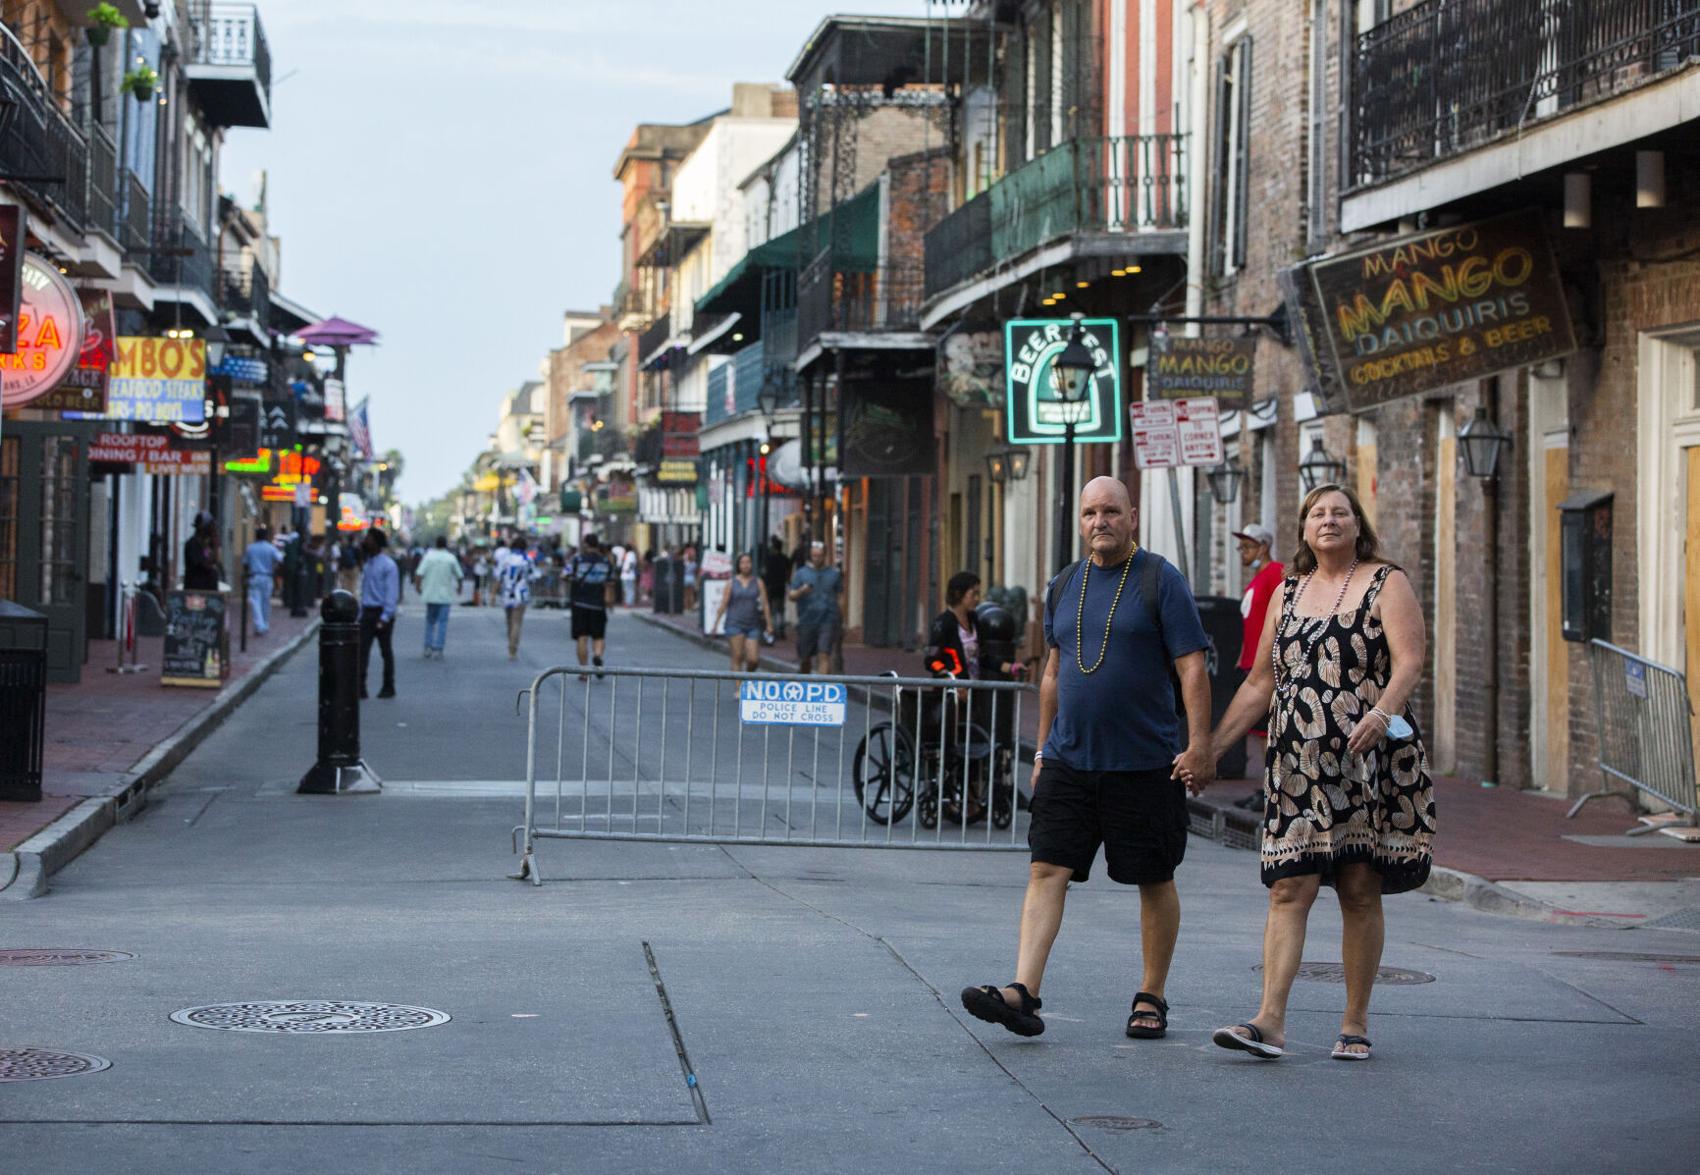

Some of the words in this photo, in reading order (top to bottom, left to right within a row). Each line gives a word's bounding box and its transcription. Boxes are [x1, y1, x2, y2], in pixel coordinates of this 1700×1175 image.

[1363, 225, 1478, 279] MANGO
[1337, 247, 1533, 342] MANGO
[1356, 292, 1530, 355] DAIQUIRIS
[1011, 323, 1061, 384] BEER
[1174, 339, 1234, 353] MANGO
[1352, 342, 1450, 384] COCKTAILS
[1459, 335, 1476, 356] &
[1487, 316, 1551, 347] BEER
[1158, 352, 1249, 375] MANGO
[101, 434, 167, 448] ROOFTOP
[148, 450, 182, 463] BAR
[752, 711, 767, 720] DO
[774, 712, 794, 721] NOT
[801, 713, 833, 722] CROSS
[760, 703, 797, 713] POLICE
[805, 704, 828, 713] LINE
